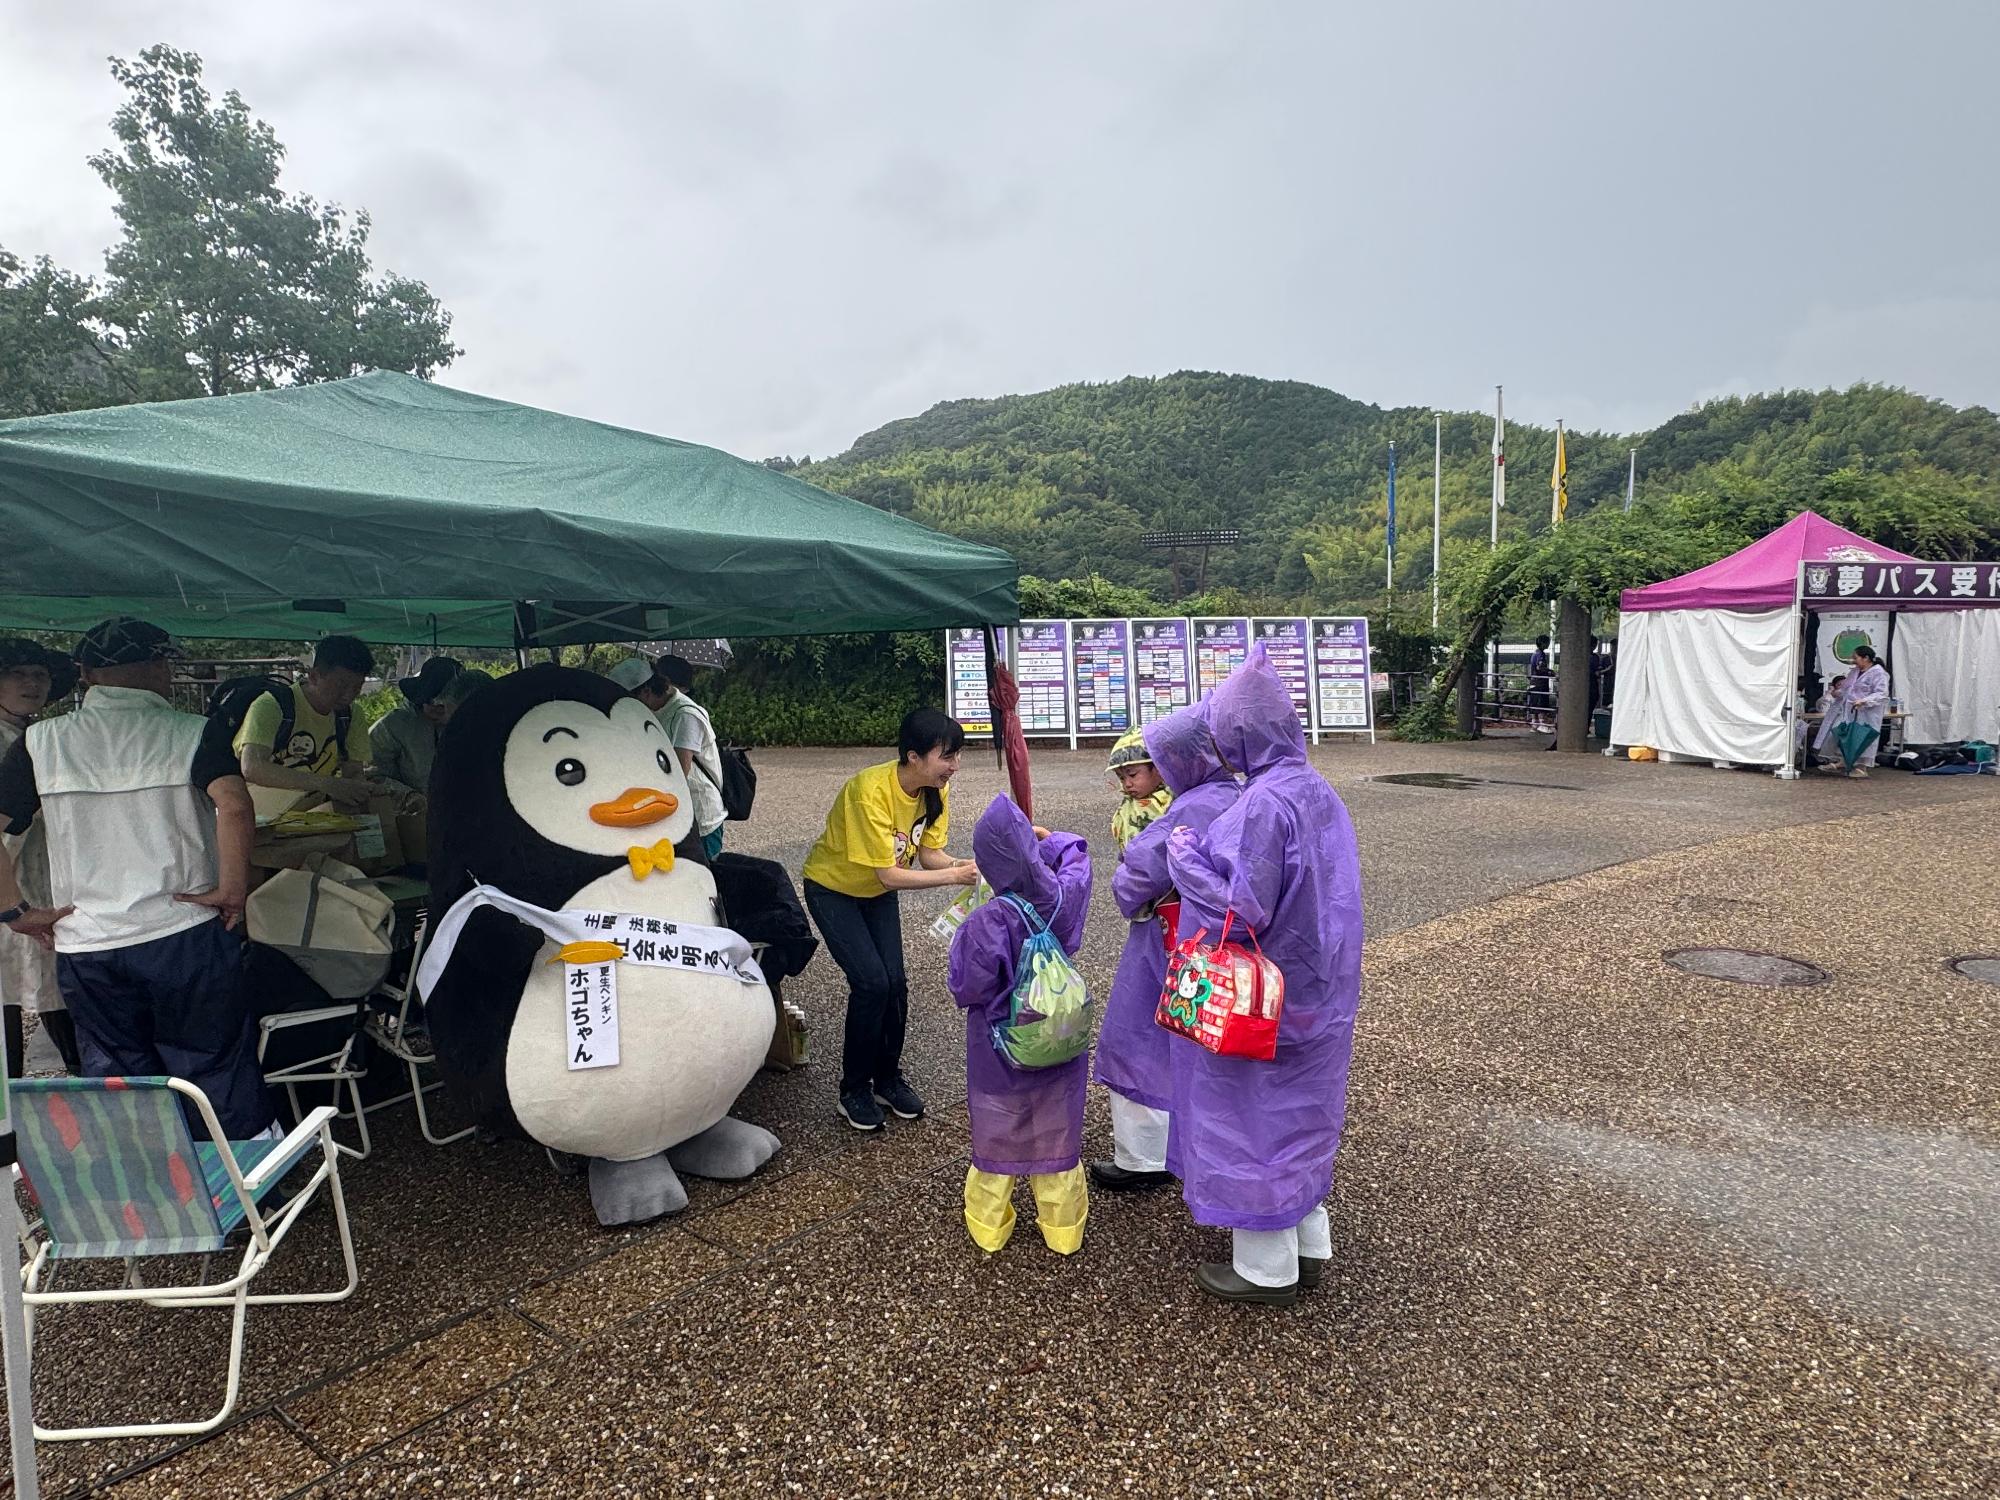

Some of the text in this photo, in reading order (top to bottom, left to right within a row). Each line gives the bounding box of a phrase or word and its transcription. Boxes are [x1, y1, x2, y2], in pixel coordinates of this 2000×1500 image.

[584, 914, 677, 935] 主唱 法務省
[570, 969, 593, 1063] ホゴちゃん
